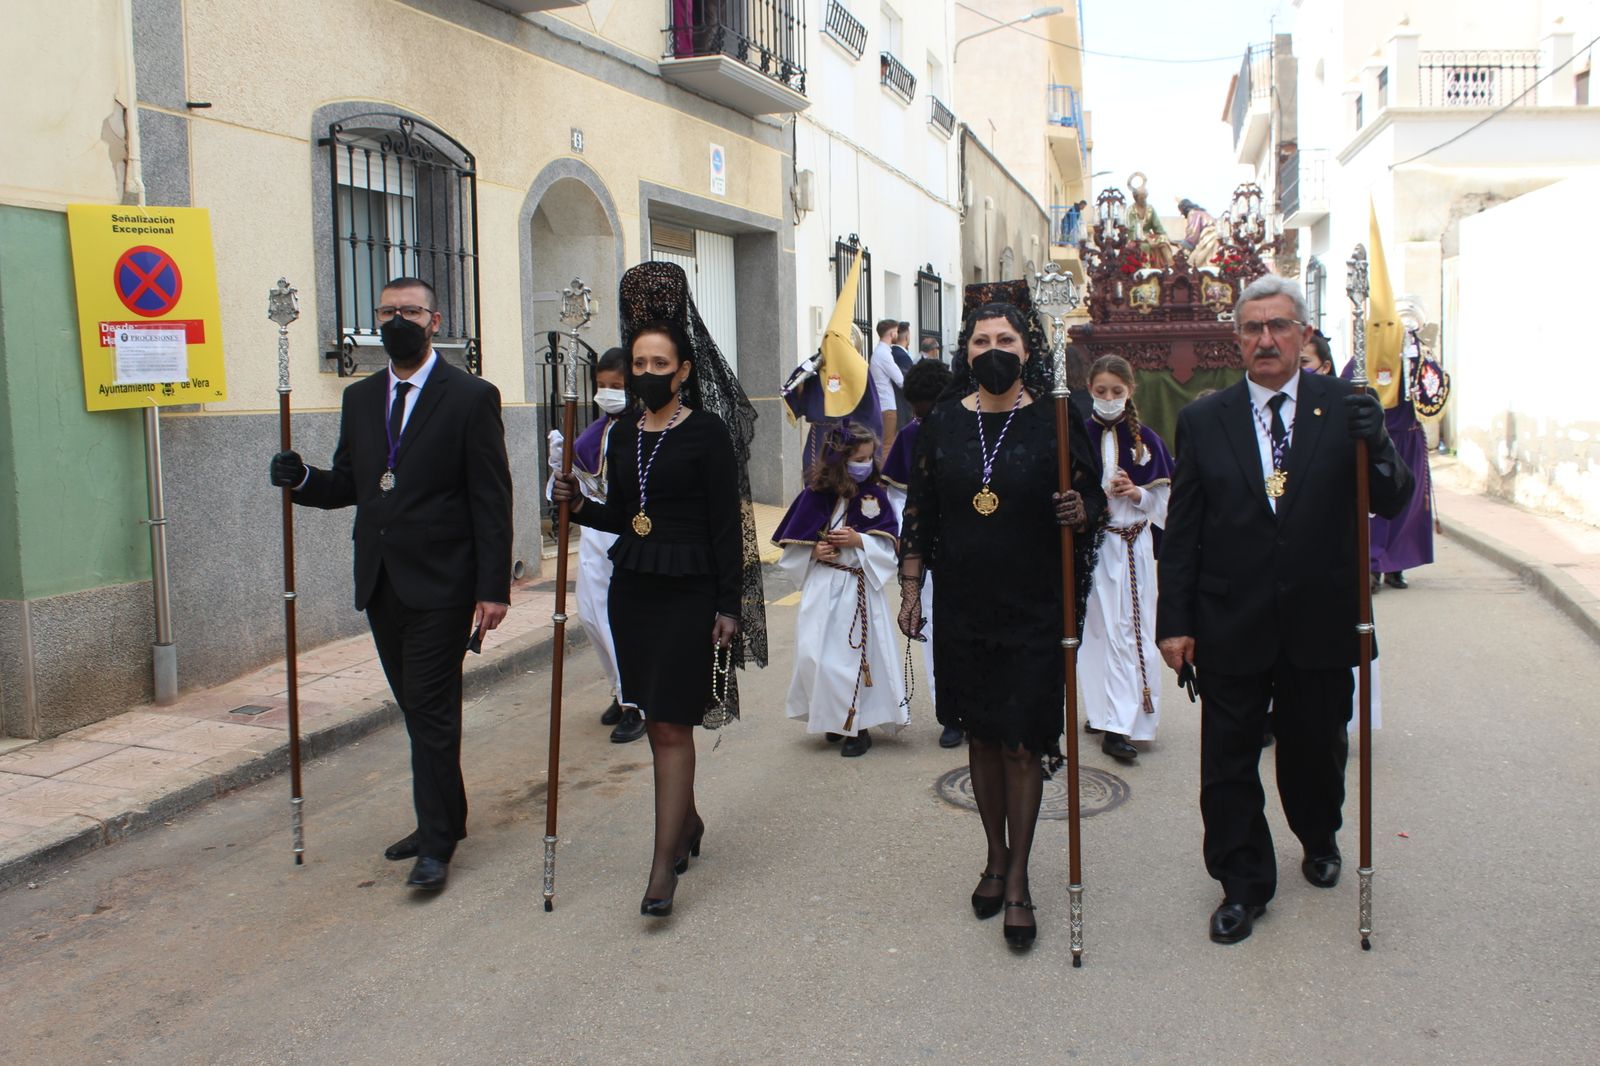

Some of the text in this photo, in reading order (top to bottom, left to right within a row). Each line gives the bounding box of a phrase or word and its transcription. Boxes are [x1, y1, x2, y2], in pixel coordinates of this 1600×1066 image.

[111, 214, 175, 224] Señalización
[112, 224, 174, 235] Excepcional
[130, 333, 179, 342] PROCESIONES
[99, 383, 156, 397] Ayuntamiento
[191, 378, 210, 388] Vera
